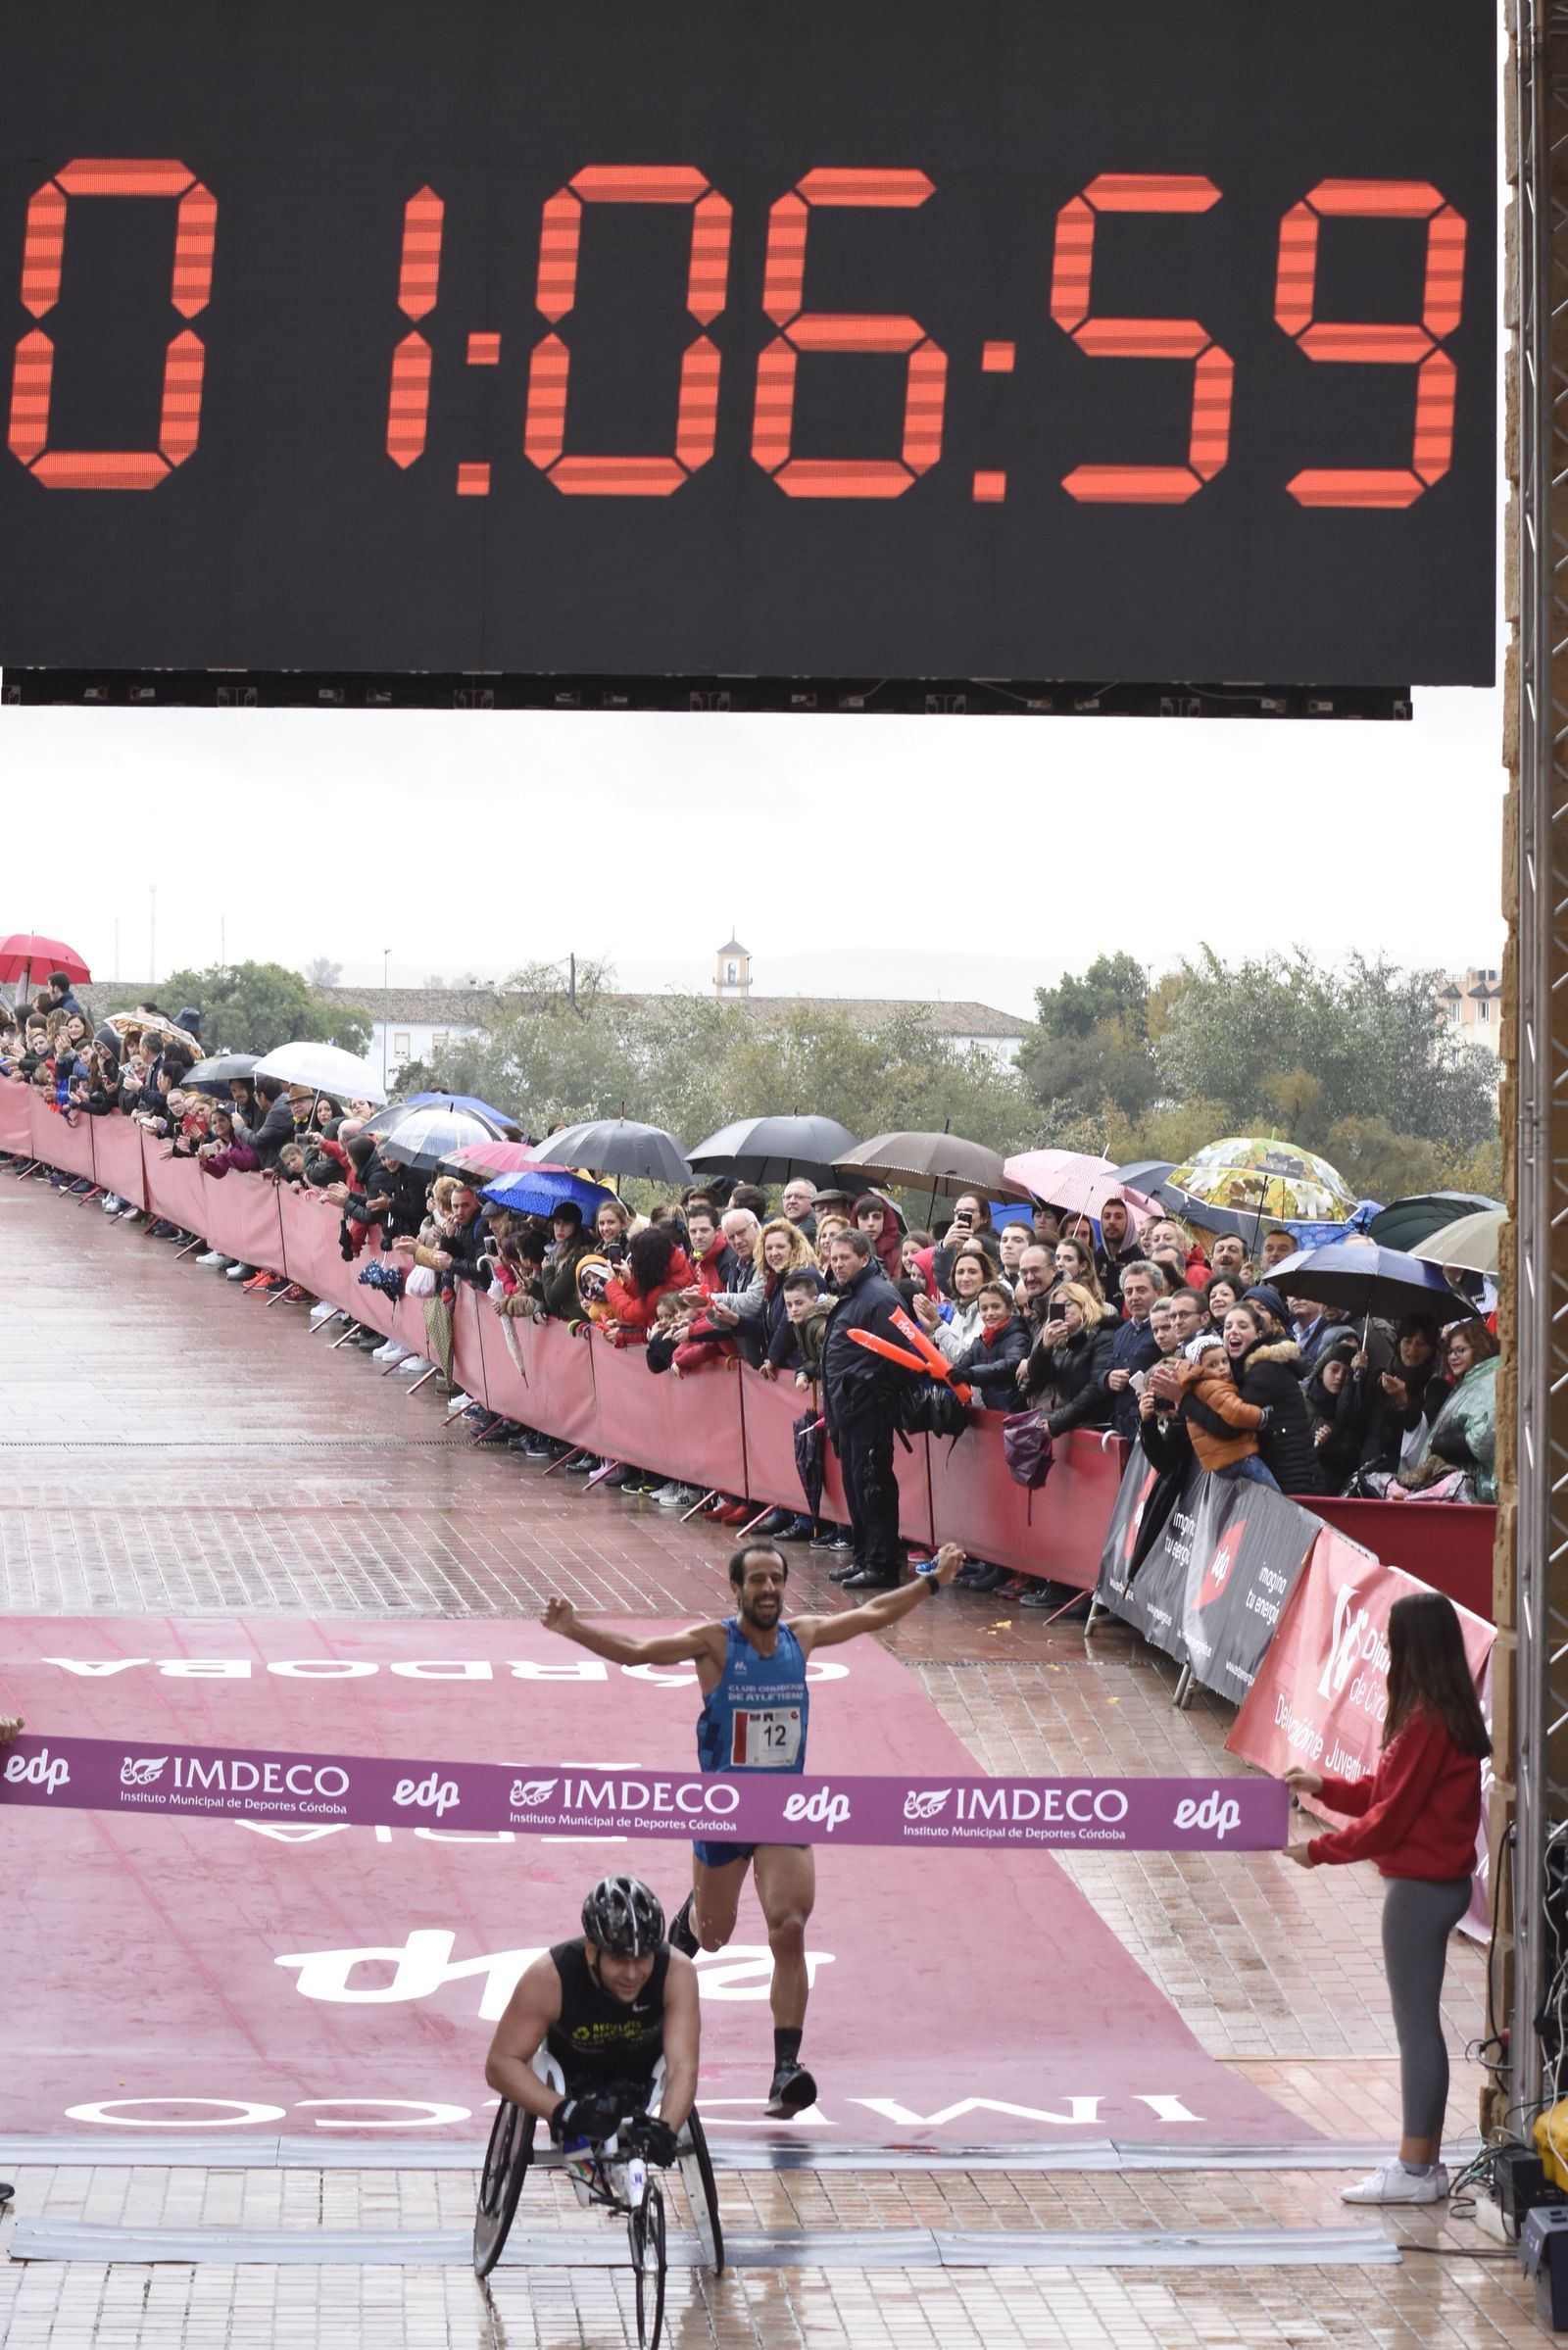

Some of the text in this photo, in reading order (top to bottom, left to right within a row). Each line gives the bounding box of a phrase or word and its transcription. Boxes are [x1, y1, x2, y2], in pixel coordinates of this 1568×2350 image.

[8, 159, 1467, 509] 01:06:59
[1246, 1588, 1280, 1627] tu energí
[728, 1692, 744, 1701] DE
[1349, 1672, 1366, 1705] de
[763, 1724, 787, 1746] 12
[3, 1747, 71, 1795] edp
[173, 1757, 351, 1797] IMDECO
[120, 1790, 348, 1815] Instituto Municipal de Deportes Córdoba
[393, 1771, 461, 1818] edp
[563, 1778, 741, 1815] IMDECO
[783, 1785, 852, 1833] edp
[956, 1787, 1130, 1823] IMDECO
[510, 1811, 557, 1826] Instituto
[559, 1813, 614, 1830] Municipal
[617, 1816, 631, 1829] de
[633, 1818, 686, 1833] Deportes
[688, 1819, 737, 1832] Córdoba
[1173, 1789, 1242, 1840] edp
[903, 1824, 1126, 1842] Instituto Municipal de Deportes Córdoba
[64, 2093, 1208, 2129] IMDCO
